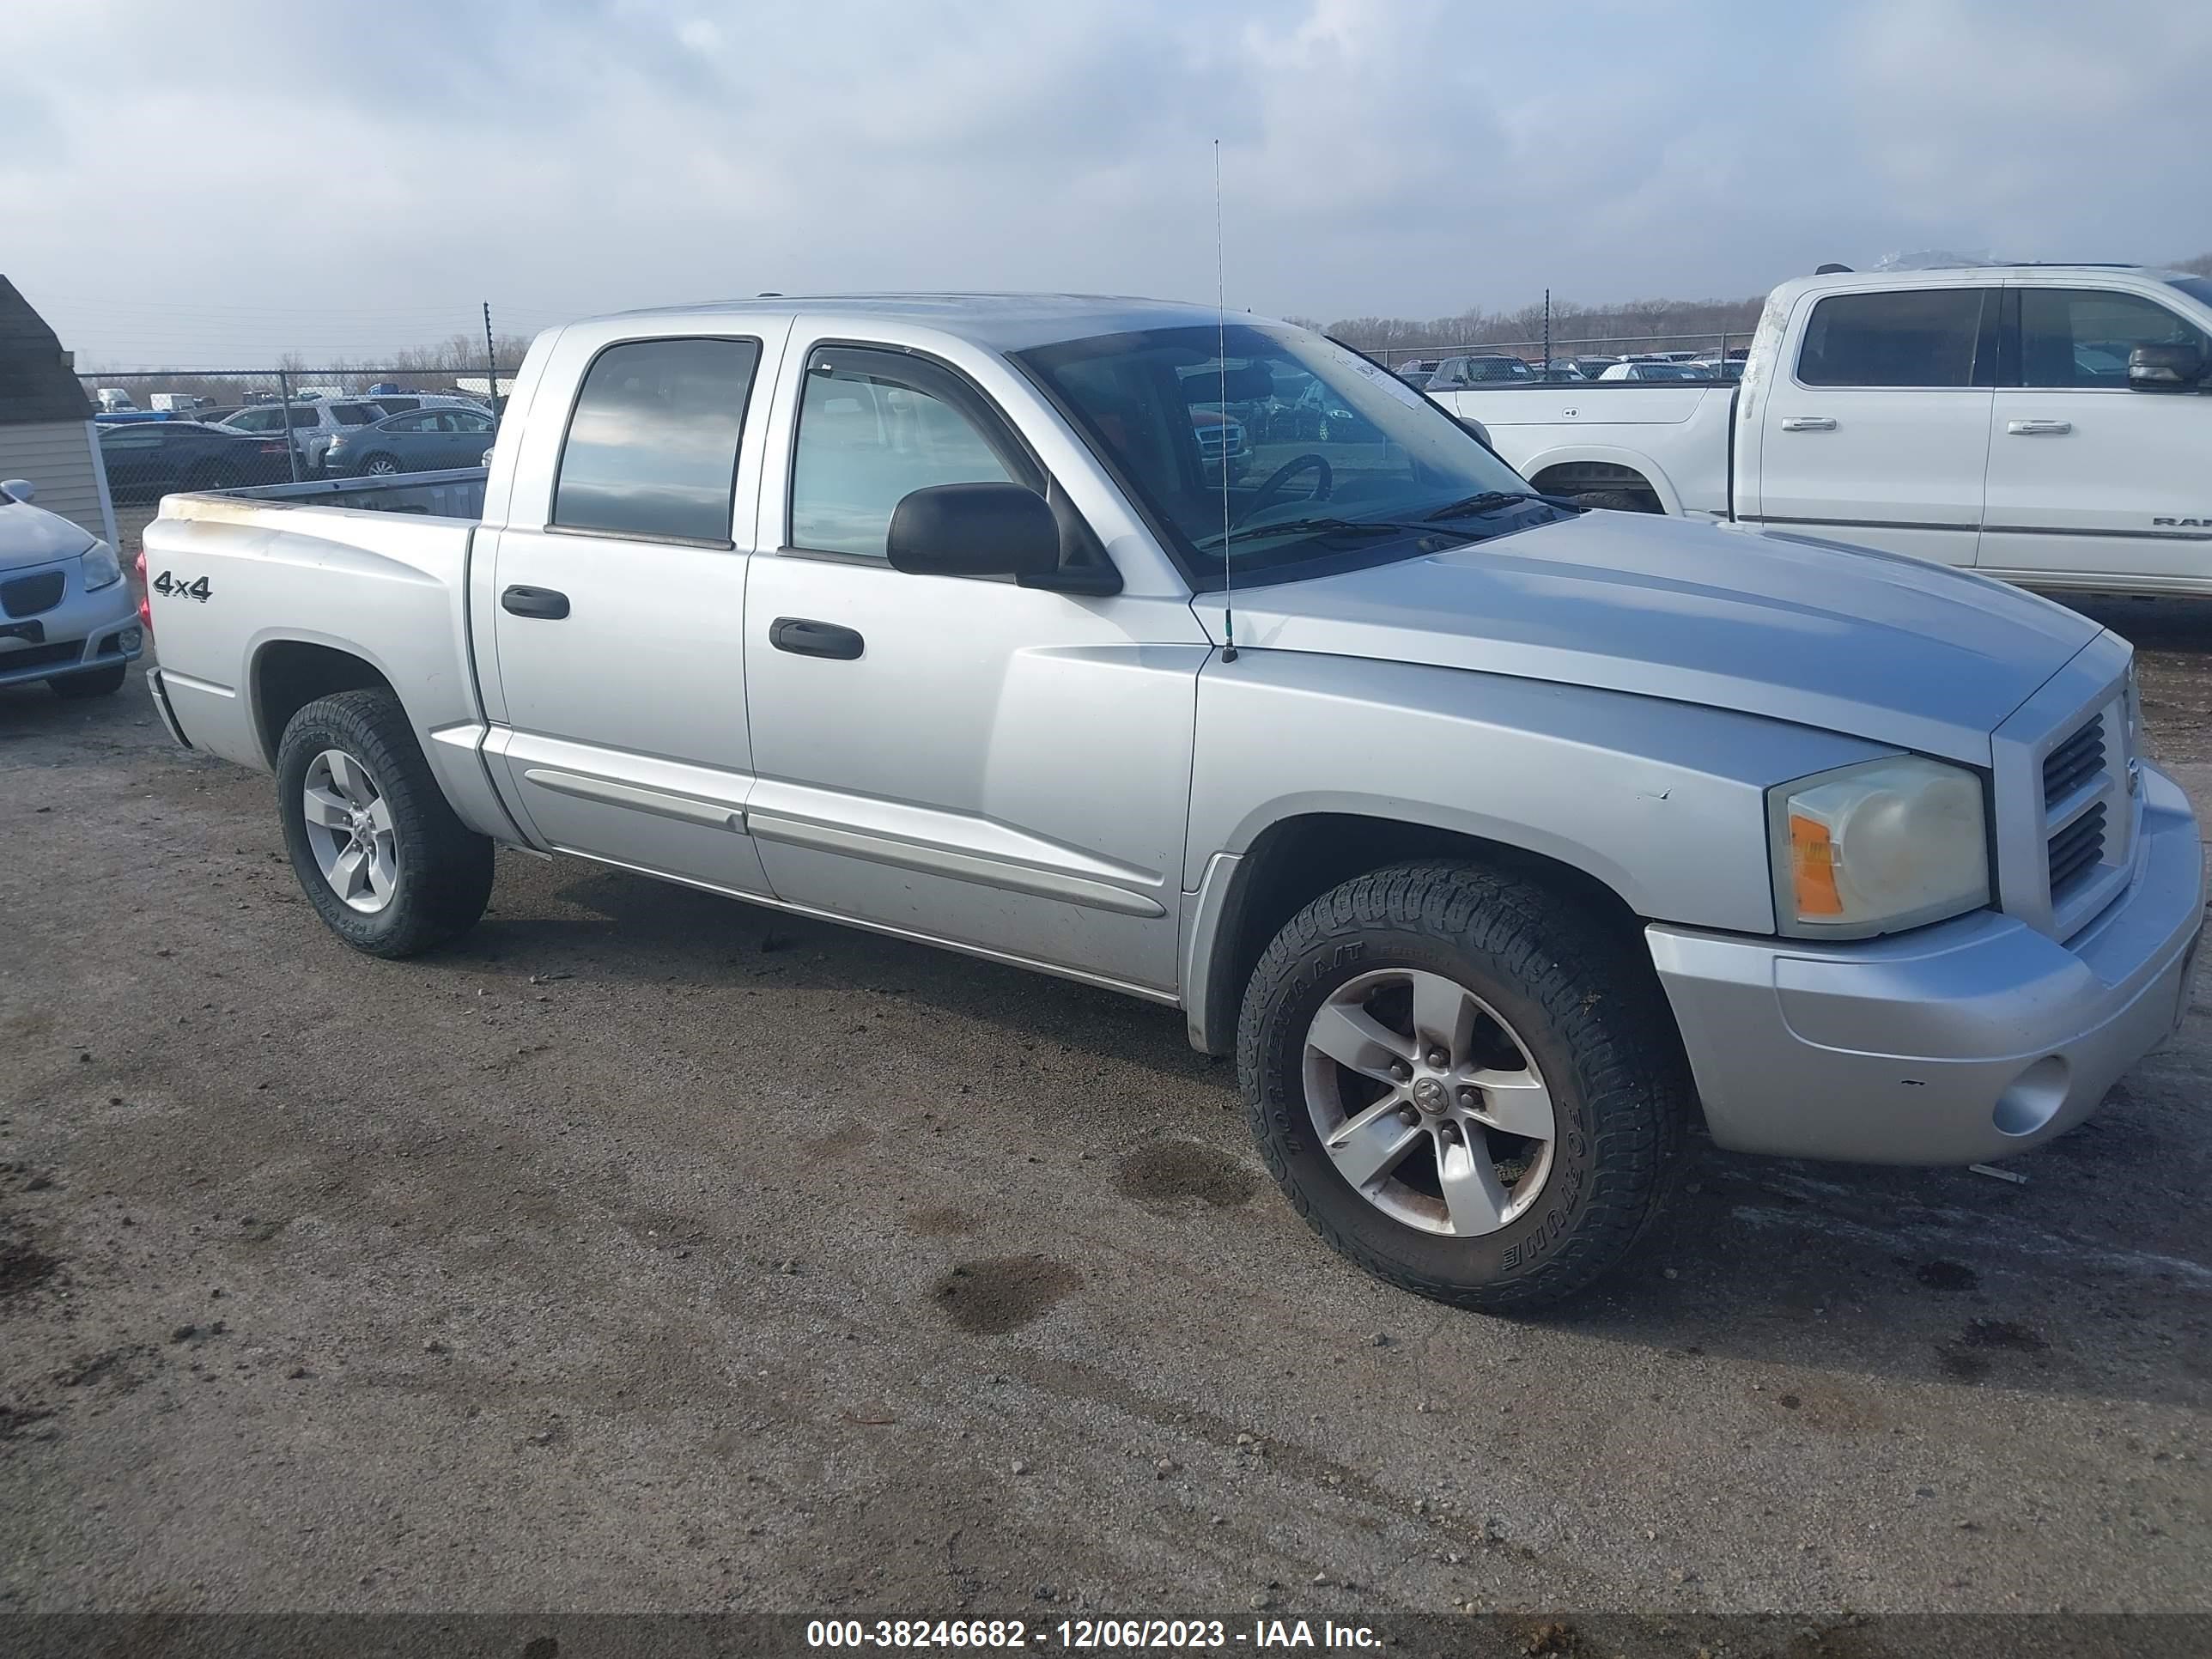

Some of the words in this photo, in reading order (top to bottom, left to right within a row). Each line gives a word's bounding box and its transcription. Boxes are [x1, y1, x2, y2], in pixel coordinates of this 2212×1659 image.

[152, 569, 214, 604] 4x4
[1313, 940, 1365, 978] A/T
[1502, 1108, 1586, 1271] FORTUNE
